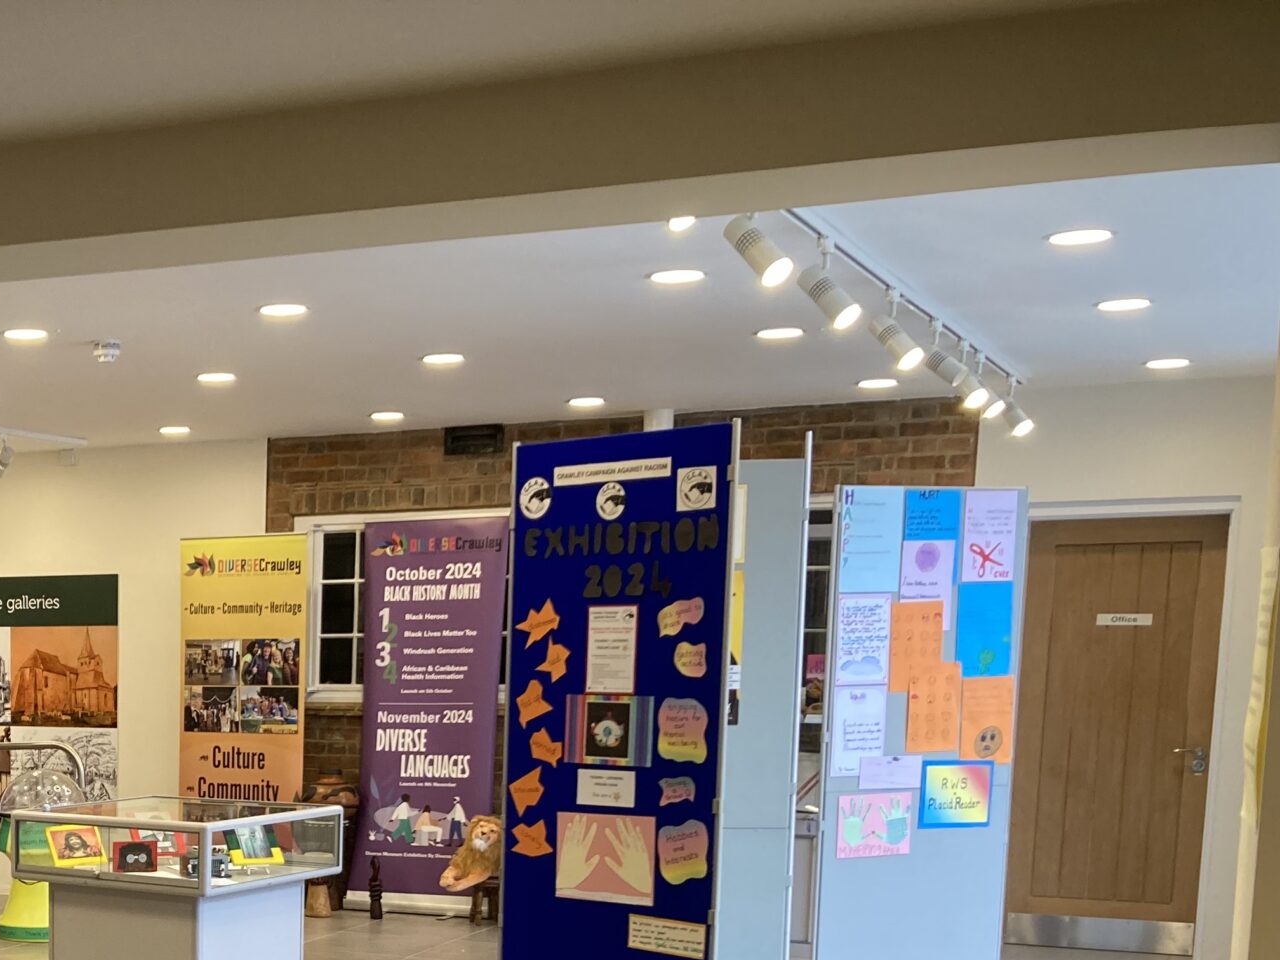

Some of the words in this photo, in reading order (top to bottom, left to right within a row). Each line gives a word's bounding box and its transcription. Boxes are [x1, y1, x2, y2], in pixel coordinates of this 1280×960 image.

[524, 513, 719, 559] EXHIBITION
[385, 566, 443, 582] October
[445, 562, 482, 579] 2024
[583, 560, 672, 599] 2024
[384, 586, 410, 602] BLACK
[412, 584, 447, 601] HISTORY
[448, 583, 481, 600] MONTH
[6, 595, 60, 614] galleries
[189, 602, 215, 616] Culture
[222, 602, 263, 617] Community
[269, 601, 302, 616] Heritage
[378, 607, 390, 633] 1
[442, 629, 464, 637] Matter
[375, 641, 391, 667] 3
[377, 711, 441, 724] November
[442, 710, 473, 724] 2024
[376, 729, 428, 752] DIVERSE
[211, 745, 265, 770] Culture
[400, 755, 470, 778] LANGUAGES
[197, 776, 280, 803] Community
